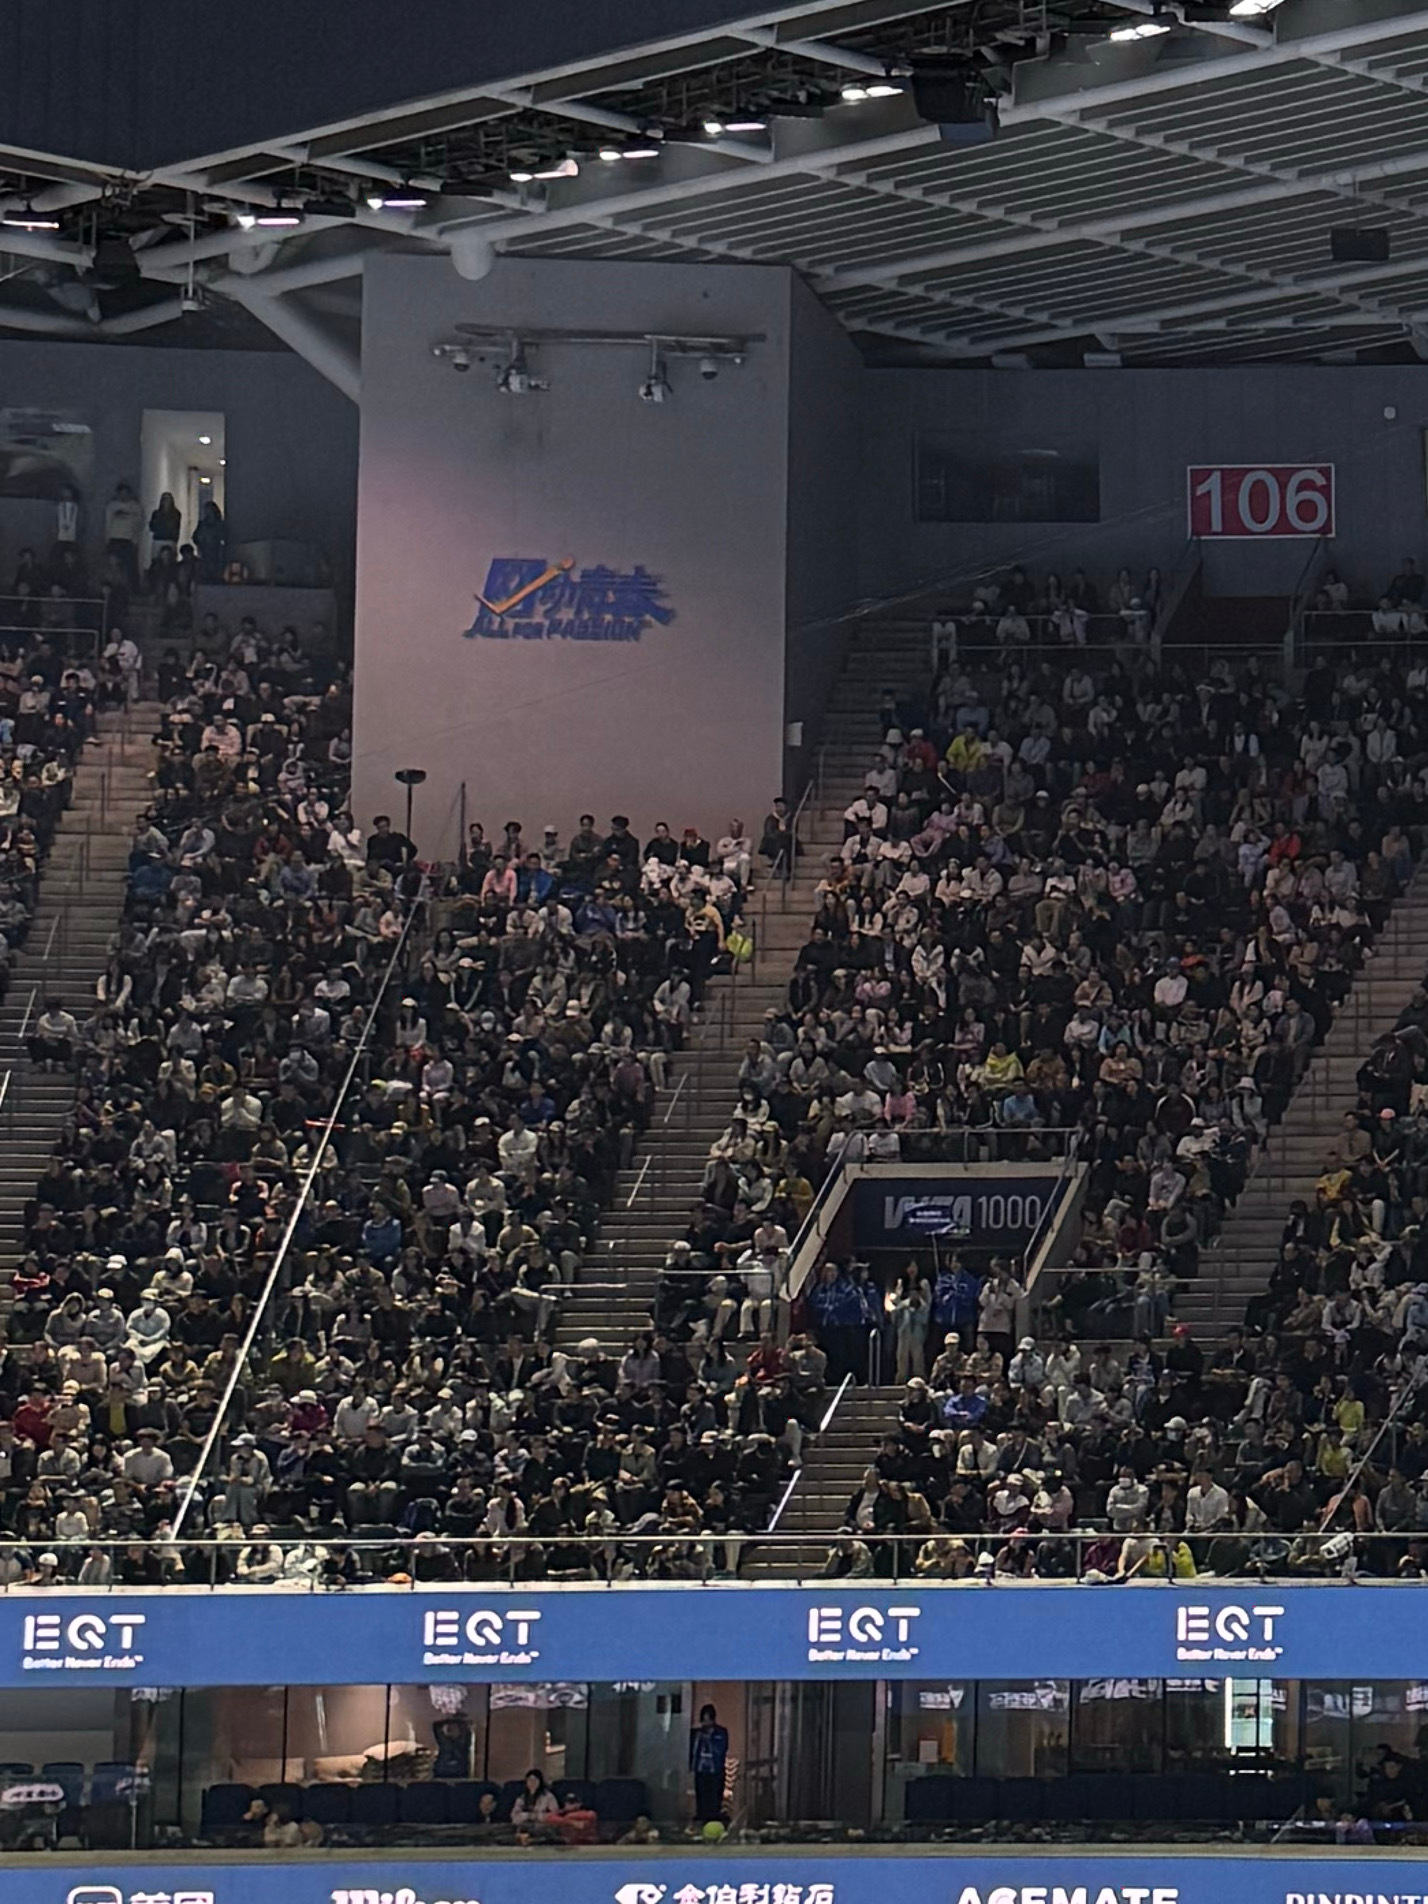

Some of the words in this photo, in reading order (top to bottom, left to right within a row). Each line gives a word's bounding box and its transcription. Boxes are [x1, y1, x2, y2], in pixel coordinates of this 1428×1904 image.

[1195, 468, 1329, 533] 106
[977, 1194, 1042, 1230] 1000
[24, 1615, 146, 1651] EQT
[424, 1610, 542, 1647] EQT
[808, 1606, 921, 1643] EQT
[1176, 1605, 1285, 1642] EQT
